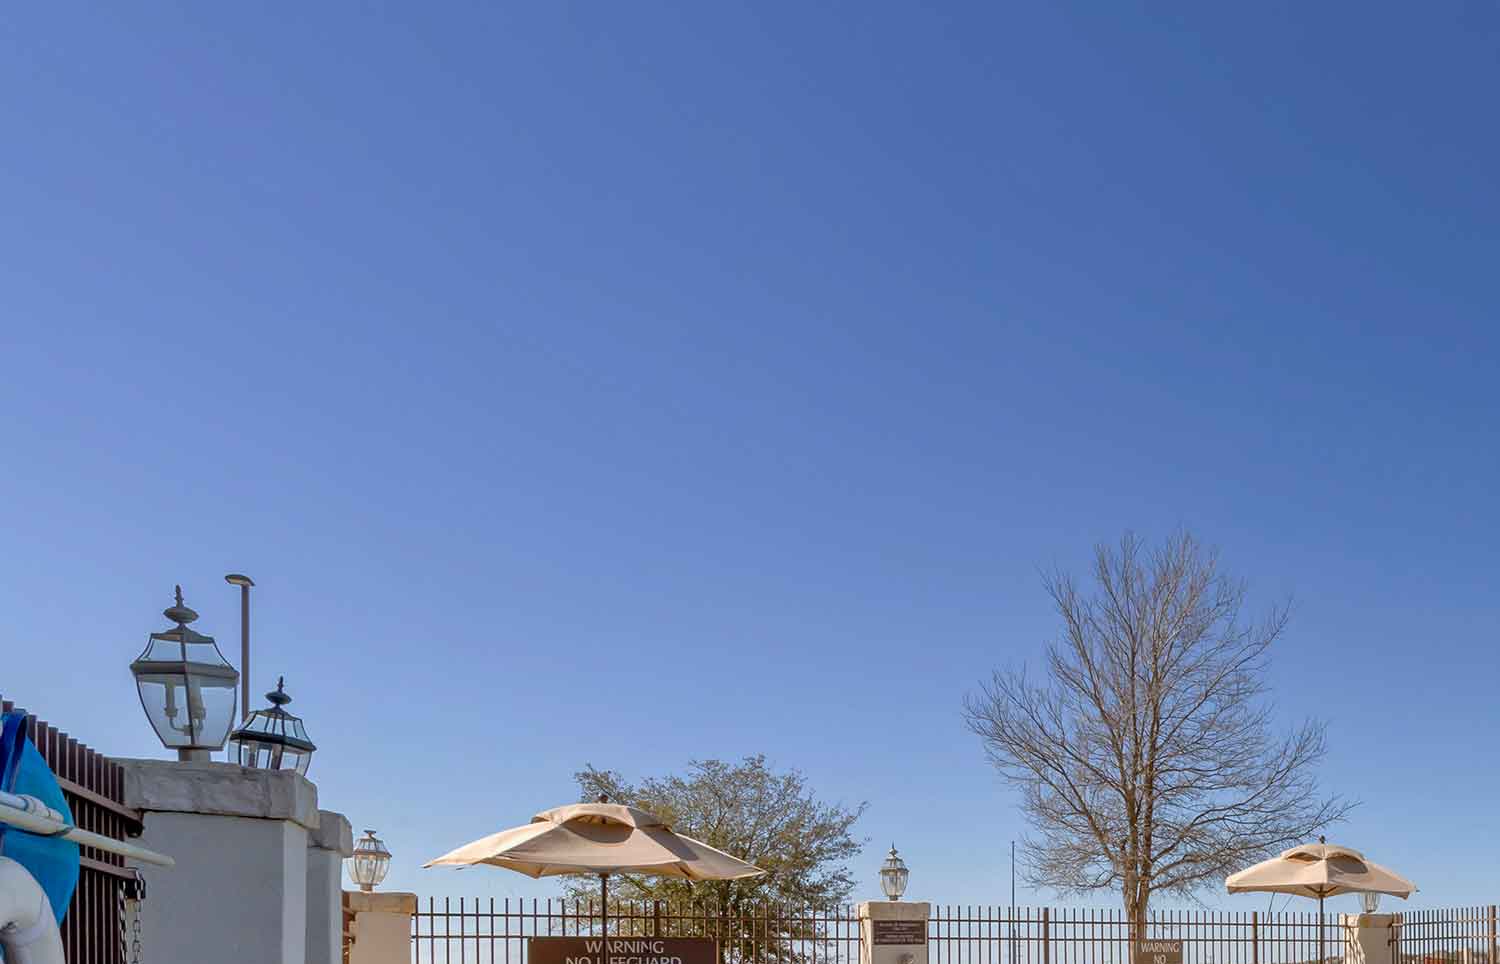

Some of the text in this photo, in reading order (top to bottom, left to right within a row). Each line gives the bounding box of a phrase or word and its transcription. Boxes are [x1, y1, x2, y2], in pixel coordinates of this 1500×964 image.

[585, 941, 664, 954] WARNING
[1141, 943, 1180, 953] WARNING
[1153, 954, 1167, 964] NO
